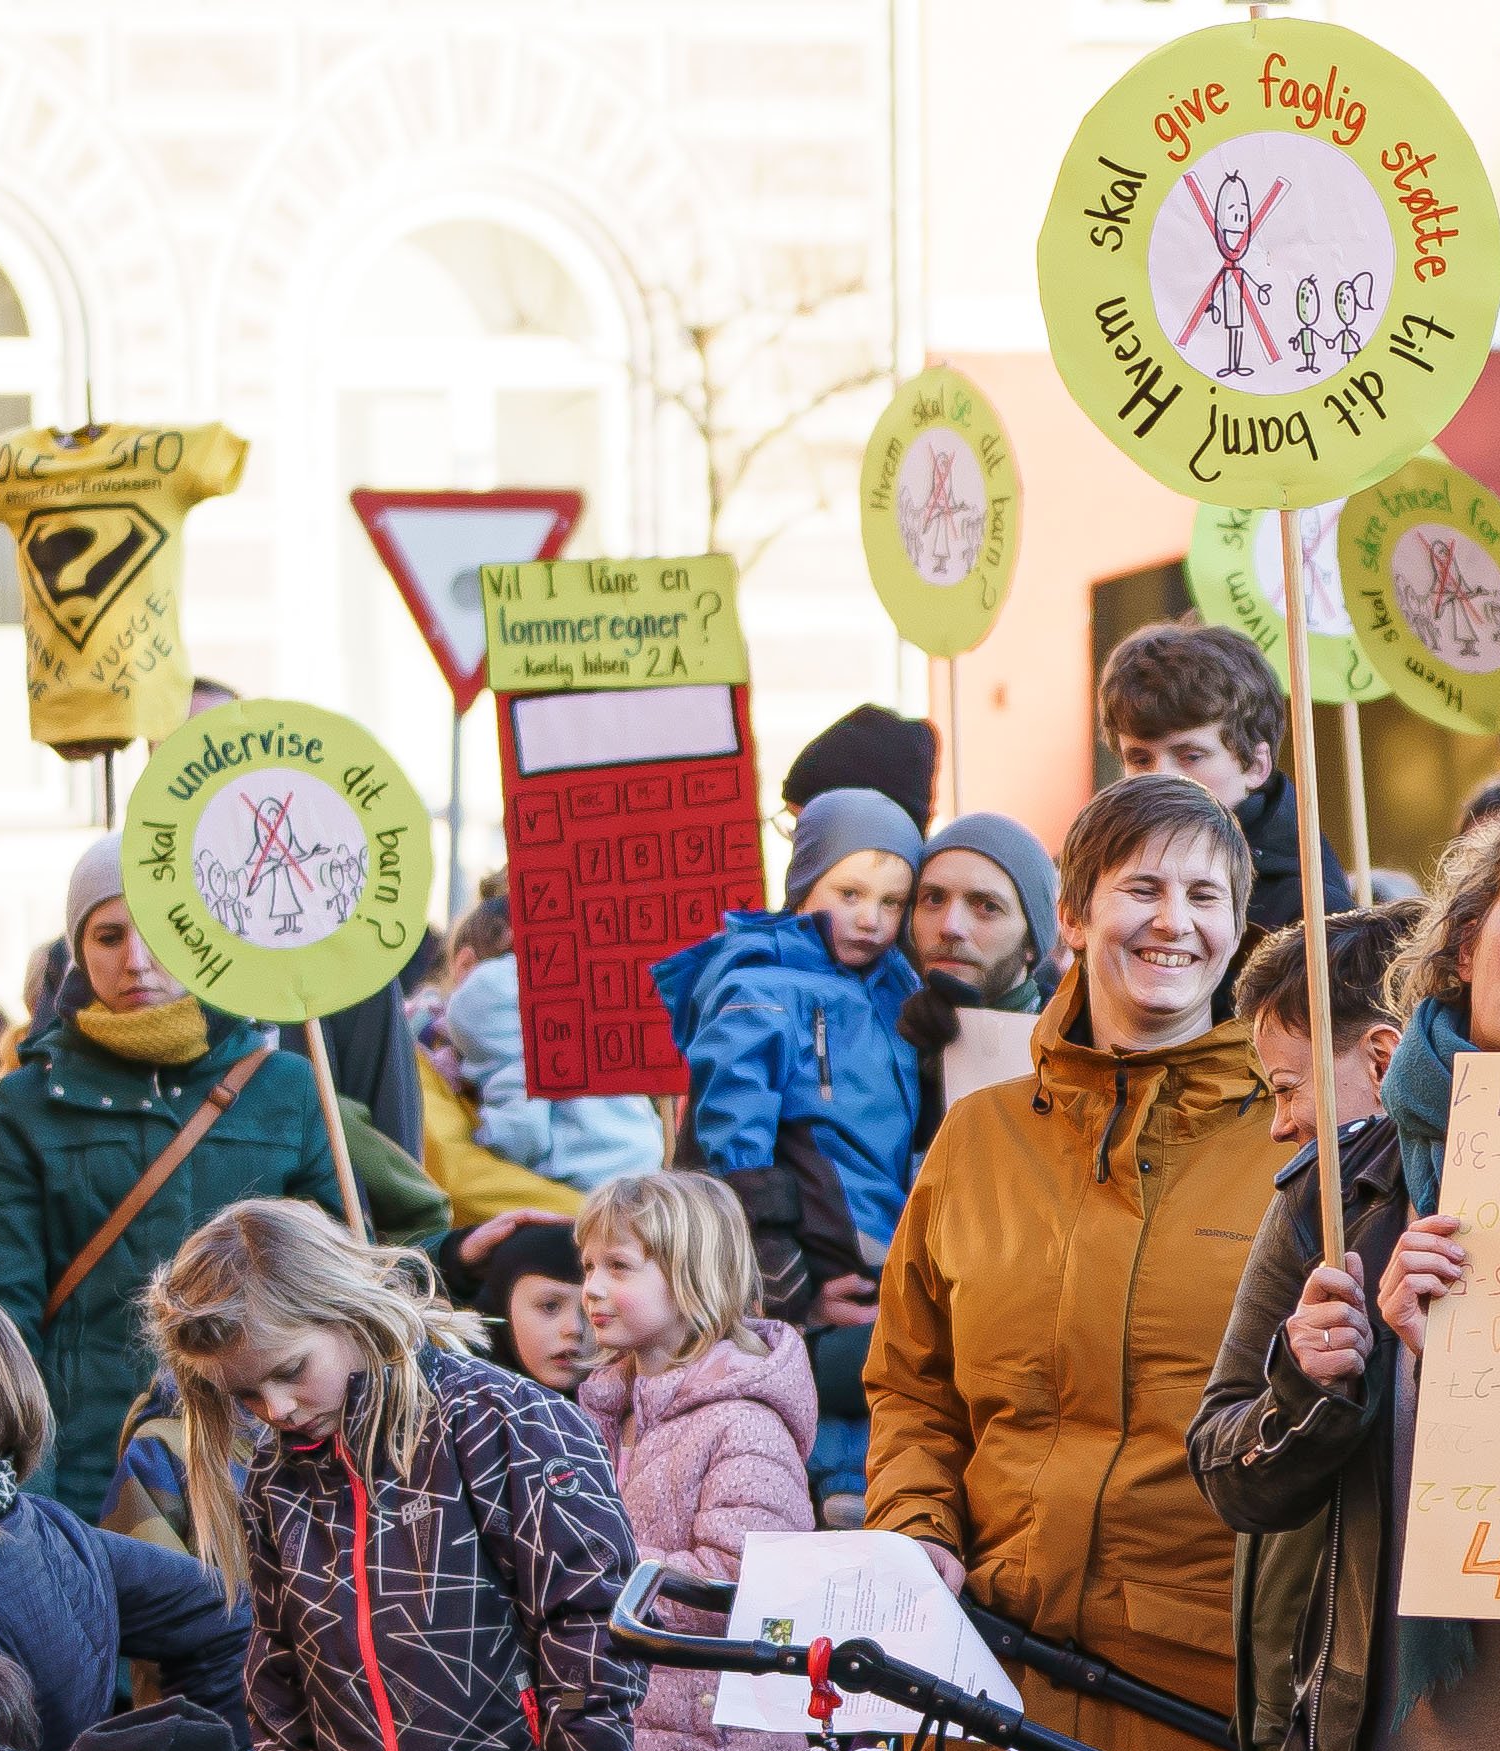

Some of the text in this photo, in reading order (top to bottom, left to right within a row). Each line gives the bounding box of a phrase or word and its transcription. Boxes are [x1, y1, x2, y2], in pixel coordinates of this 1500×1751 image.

[1154, 82, 1229, 162] give
[1259, 54, 1367, 145] faglig
[1084, 156, 1147, 252] skal
[1381, 143, 1458, 283] støtte
[1095, 296, 1182, 438] Hvem
[1389, 313, 1455, 373] til
[1324, 371, 1387, 436] dit
[870, 437, 902, 511] Hvem
[912, 383, 945, 427] skal
[980, 434, 1005, 478] dit
[486, 566, 522, 600] Vil
[546, 562, 558, 600] I
[661, 566, 690, 592] en
[1361, 589, 1399, 643] skal
[1404, 656, 1463, 712] Hvem
[167, 722, 324, 801] undervise
[343, 764, 389, 812] dit
[139, 820, 177, 882] skal
[168, 902, 233, 988] Hvem
